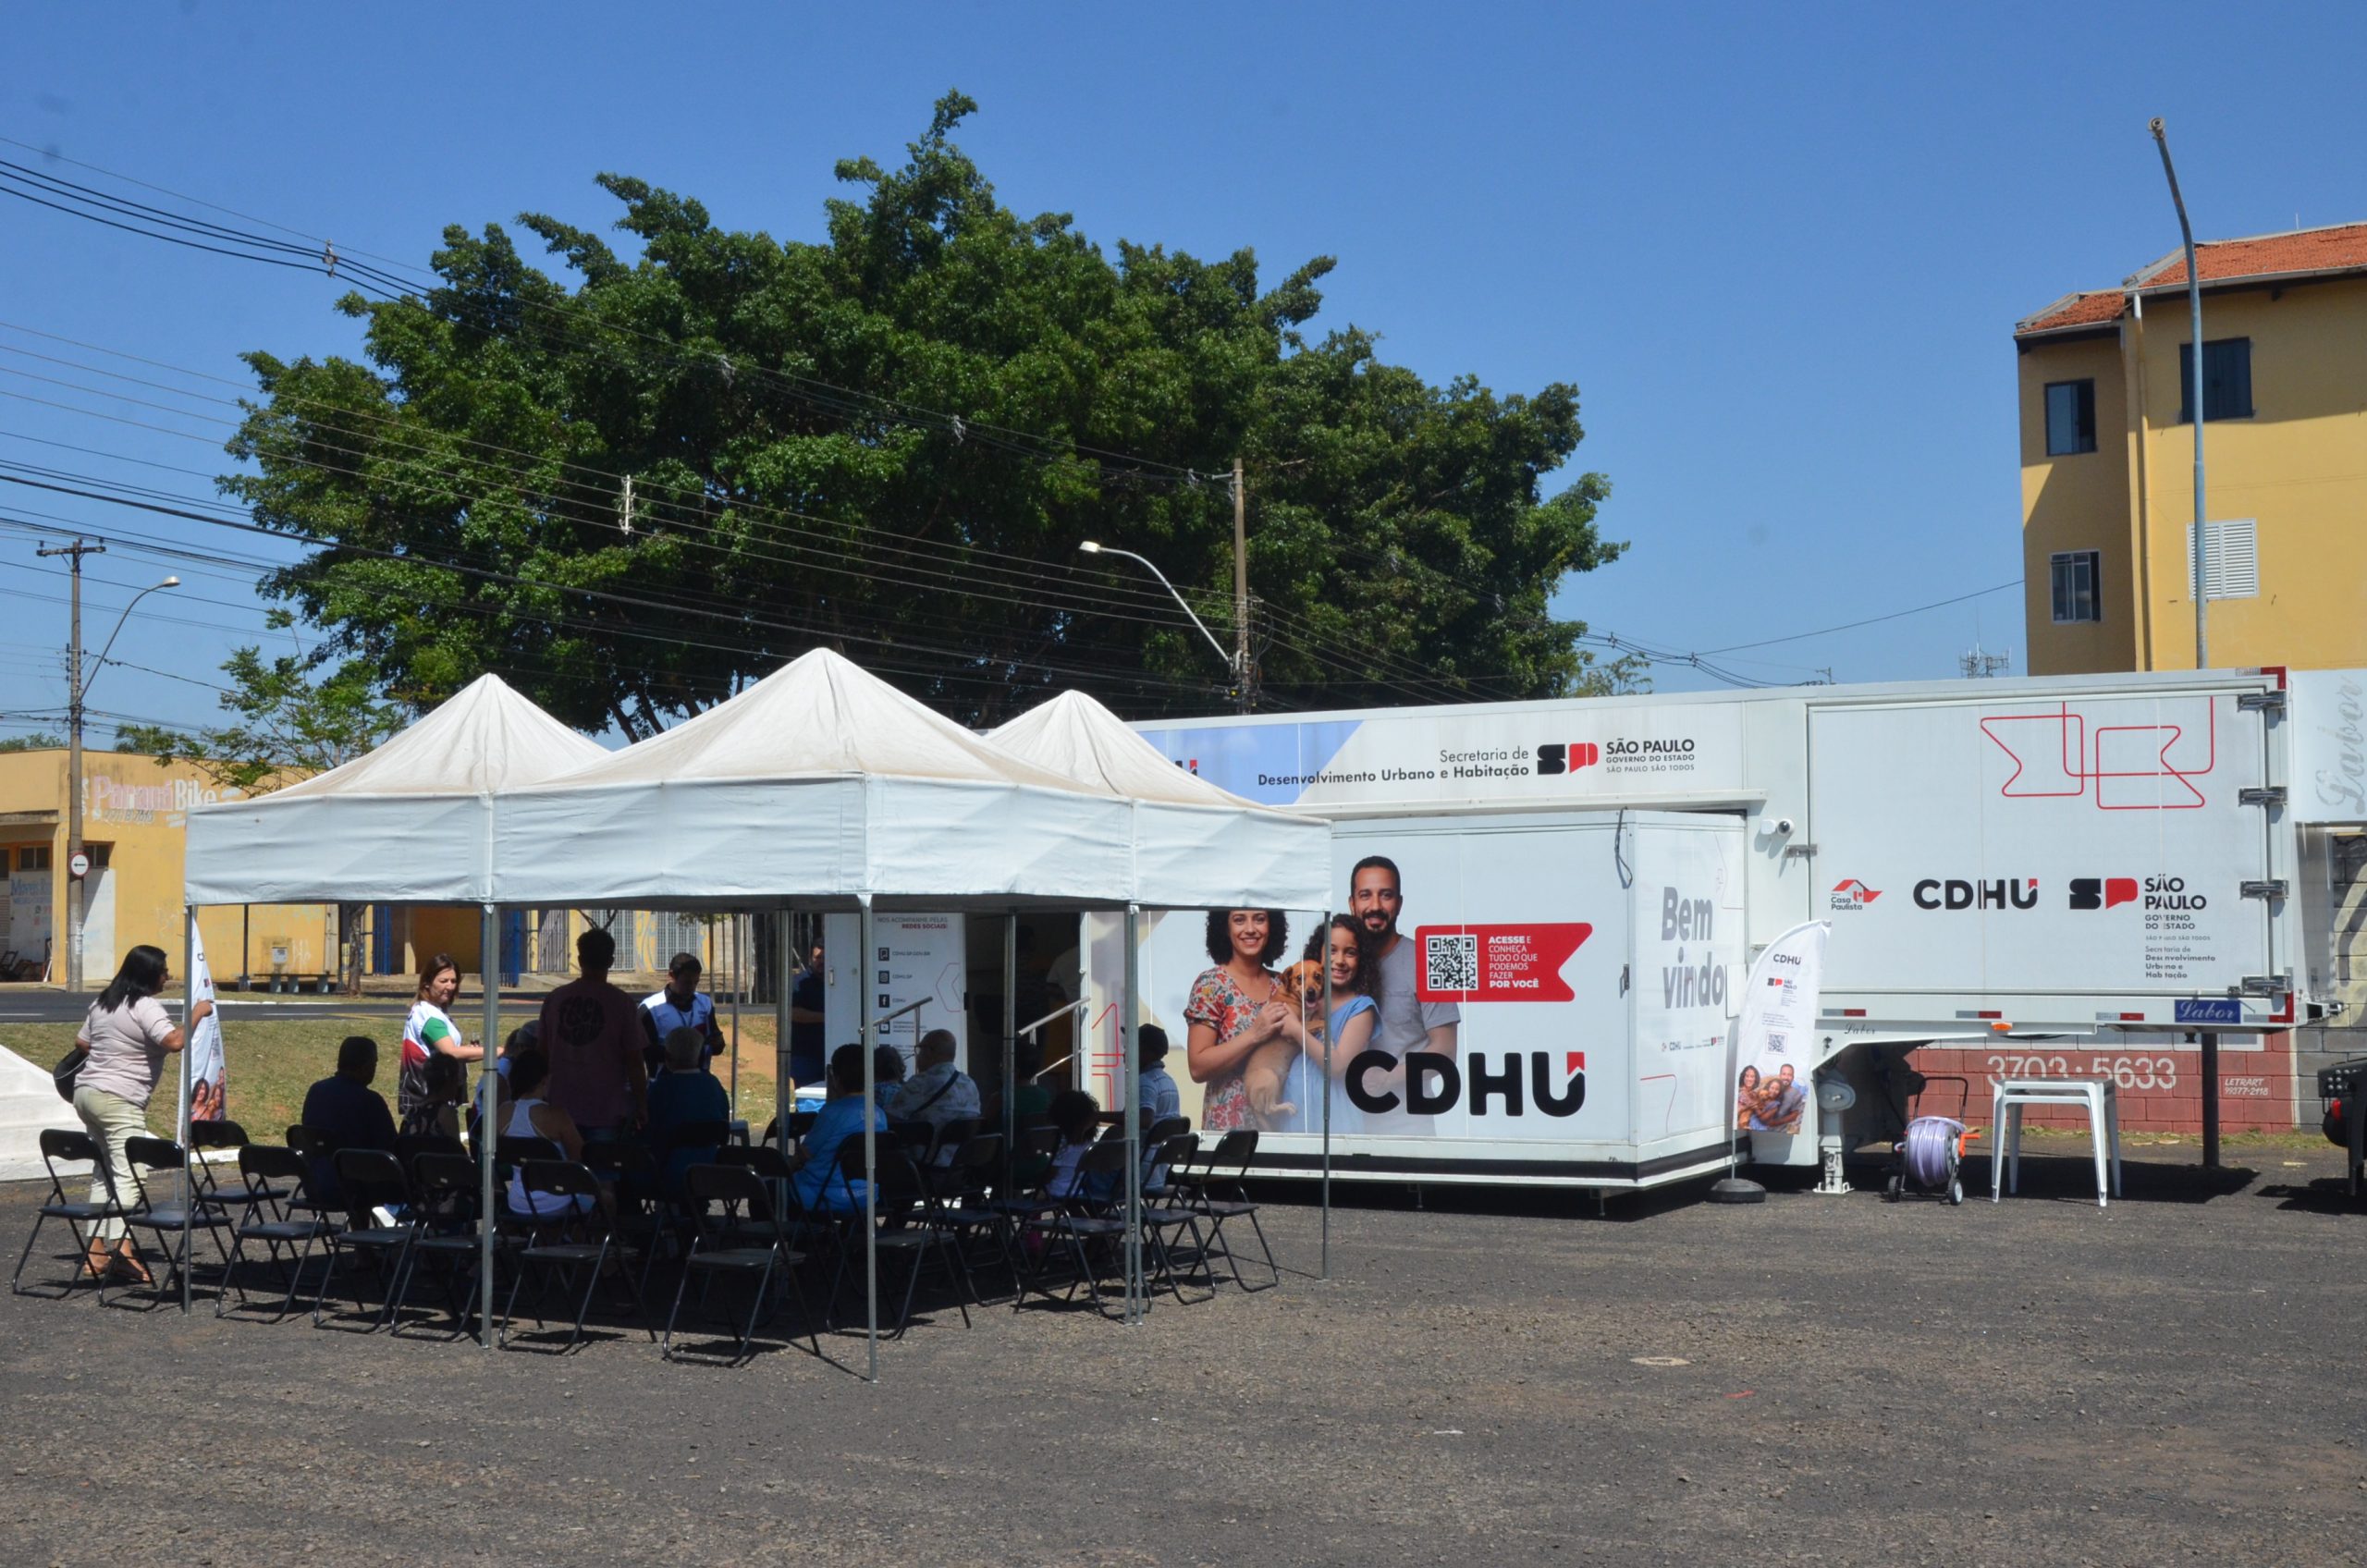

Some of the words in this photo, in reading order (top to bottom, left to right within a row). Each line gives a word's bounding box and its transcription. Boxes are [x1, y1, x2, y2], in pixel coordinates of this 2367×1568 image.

[1606, 738, 1639, 755] SÃO
[1643, 738, 1695, 753] PAULO
[1440, 747, 1508, 763] Secretaria
[1513, 745, 1529, 760] de
[1606, 755, 1647, 764] GOVERNO
[1650, 754, 1662, 763] DO
[1664, 753, 1695, 762] ESTADO
[1257, 769, 1377, 786] Desenvolvimento
[1381, 766, 1435, 781] Urbano
[1441, 768, 1449, 778] e
[1453, 764, 1529, 780] Habitação
[1606, 765, 1622, 773] SÃO
[1625, 765, 1648, 773] PAULO
[1651, 764, 1666, 772] SÃO
[93, 775, 174, 812] Paraná
[175, 779, 217, 811] Bike
[2144, 873, 2185, 893] SÃO
[1913, 877, 2039, 911] CDHU
[2144, 894, 2207, 911] PAULO
[1661, 886, 1713, 942] Bem
[2144, 913, 2191, 922] GOVERNO
[1489, 936, 1525, 944] ACESSE
[1489, 945, 1527, 954] CONHEÇA
[2182, 945, 2191, 953] de
[1521, 954, 1538, 962] QUE
[1772, 953, 1802, 966] CDHU
[1489, 962, 1528, 971] PODEMOS
[1513, 978, 1539, 987] VOCÊ
[1662, 946, 1725, 1010] vindo
[2145, 972, 2188, 980] Habtação
[2179, 1000, 2235, 1019] Labor
[1345, 1049, 1586, 1118] CDHU
[2225, 1077, 2264, 1086] LETRART
